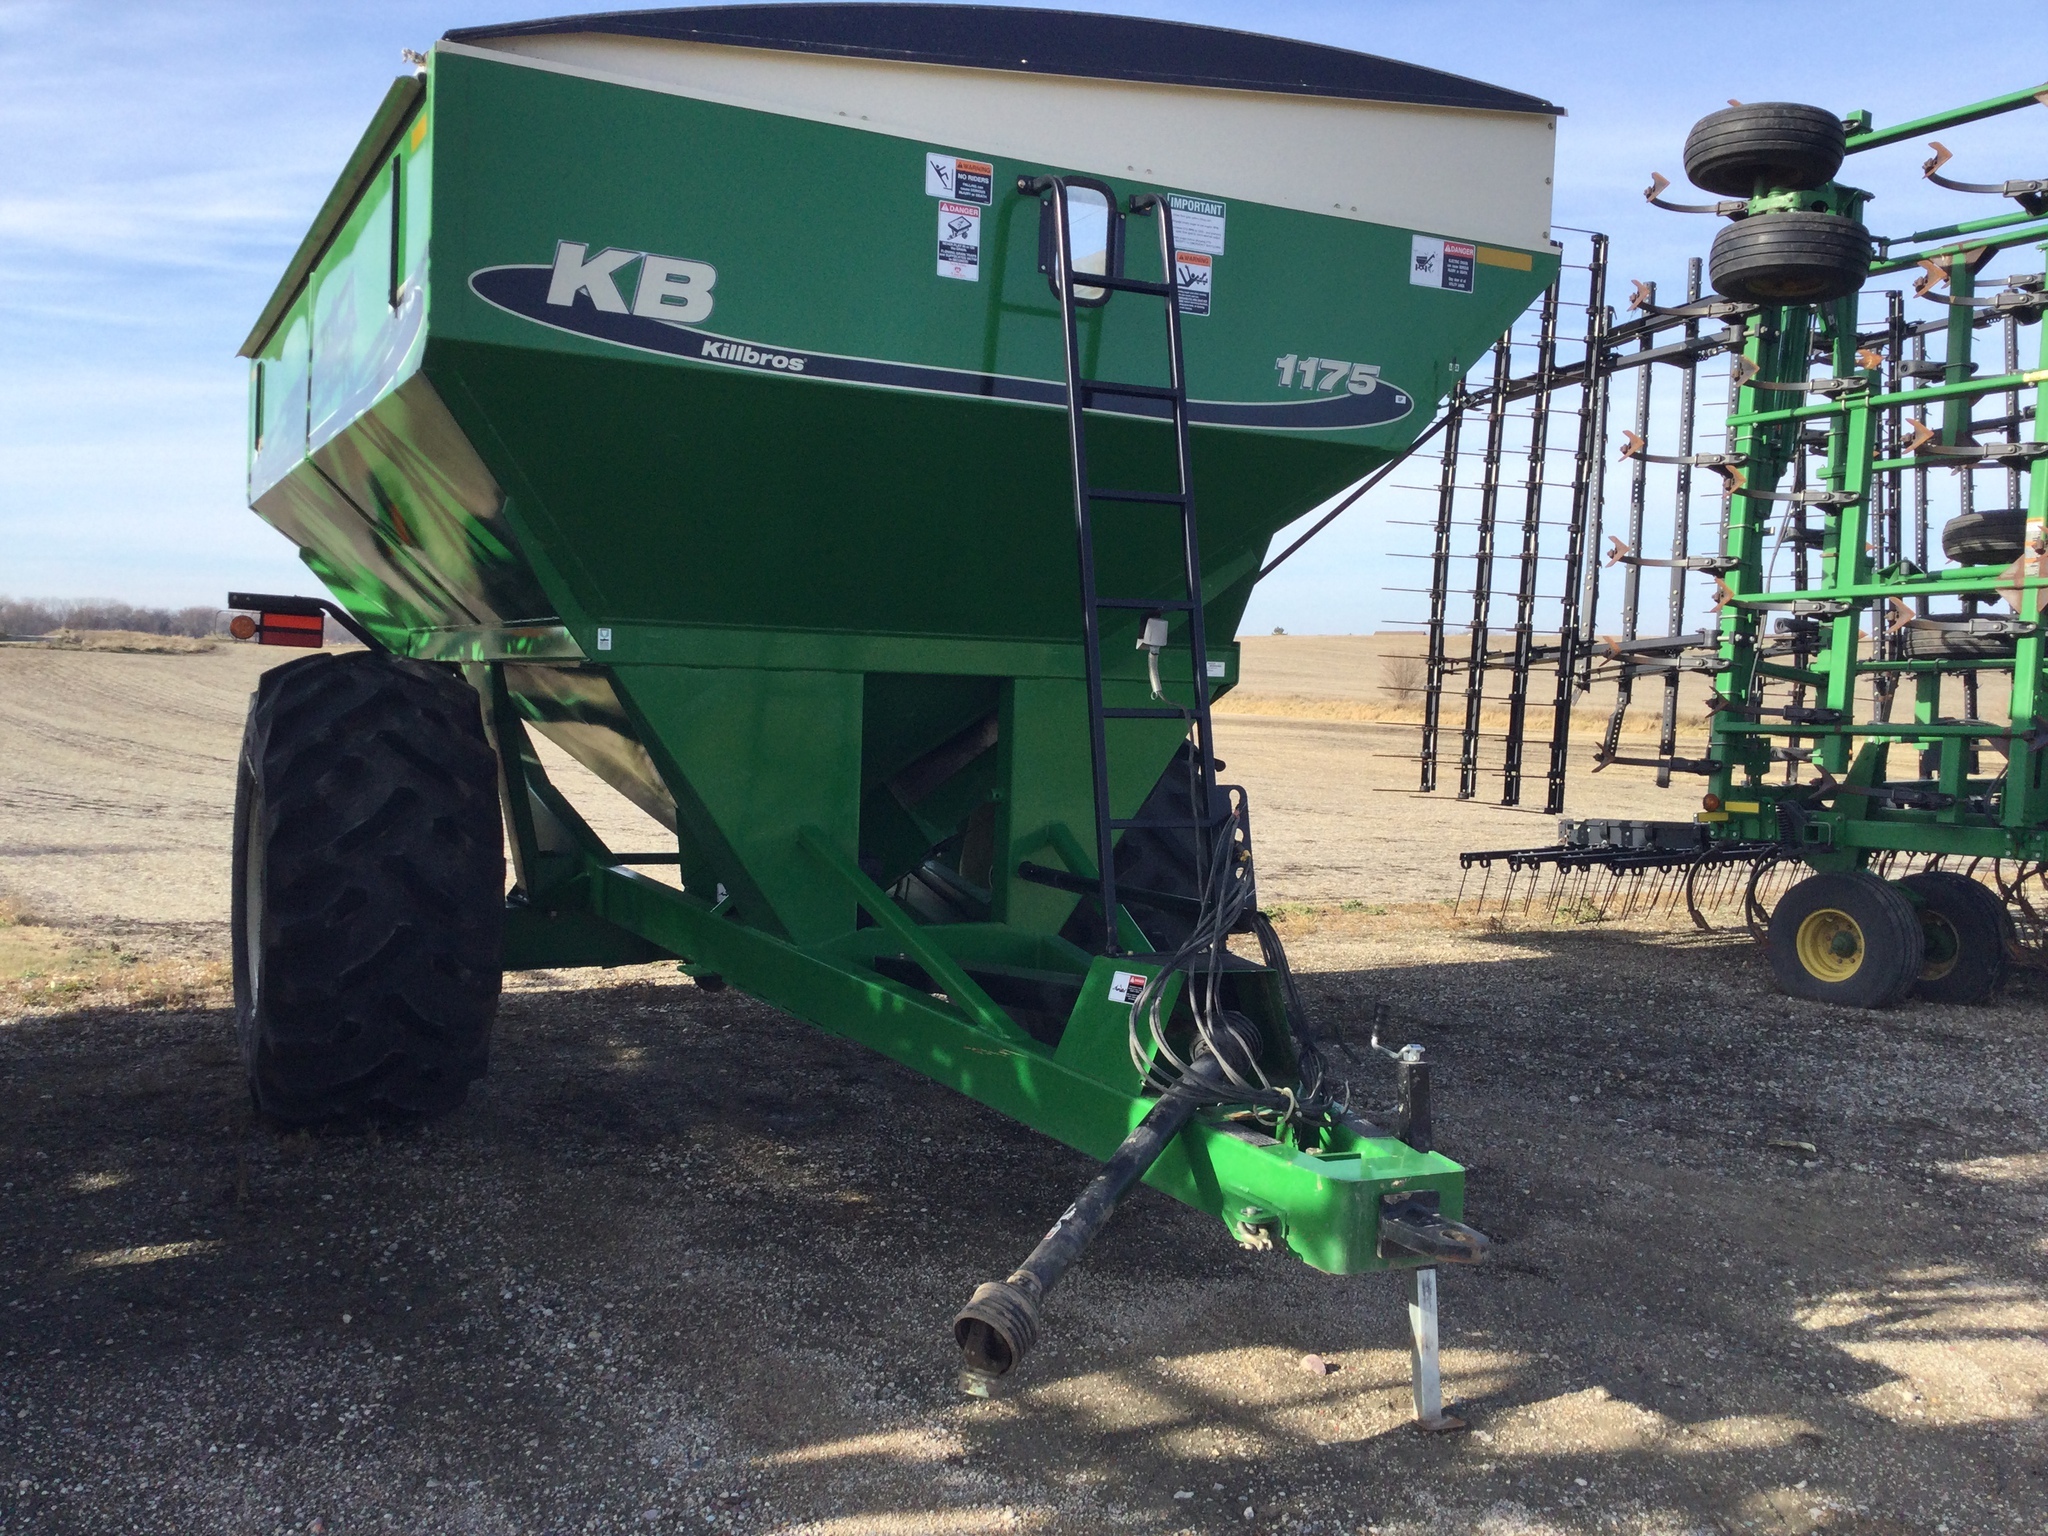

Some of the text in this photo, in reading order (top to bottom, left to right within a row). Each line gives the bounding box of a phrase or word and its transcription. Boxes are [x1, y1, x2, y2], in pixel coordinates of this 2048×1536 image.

[964, 163, 990, 173] WARNING
[968, 175, 989, 184] RIDERS
[949, 205, 978, 216] DANGER
[1170, 196, 1223, 214] IMPORTANT
[1450, 245, 1474, 255] DANGER
[1185, 255, 1209, 264] WARNING
[547, 239, 717, 324] KB
[701, 340, 804, 371] Killbros
[1275, 354, 1380, 395] 1175
